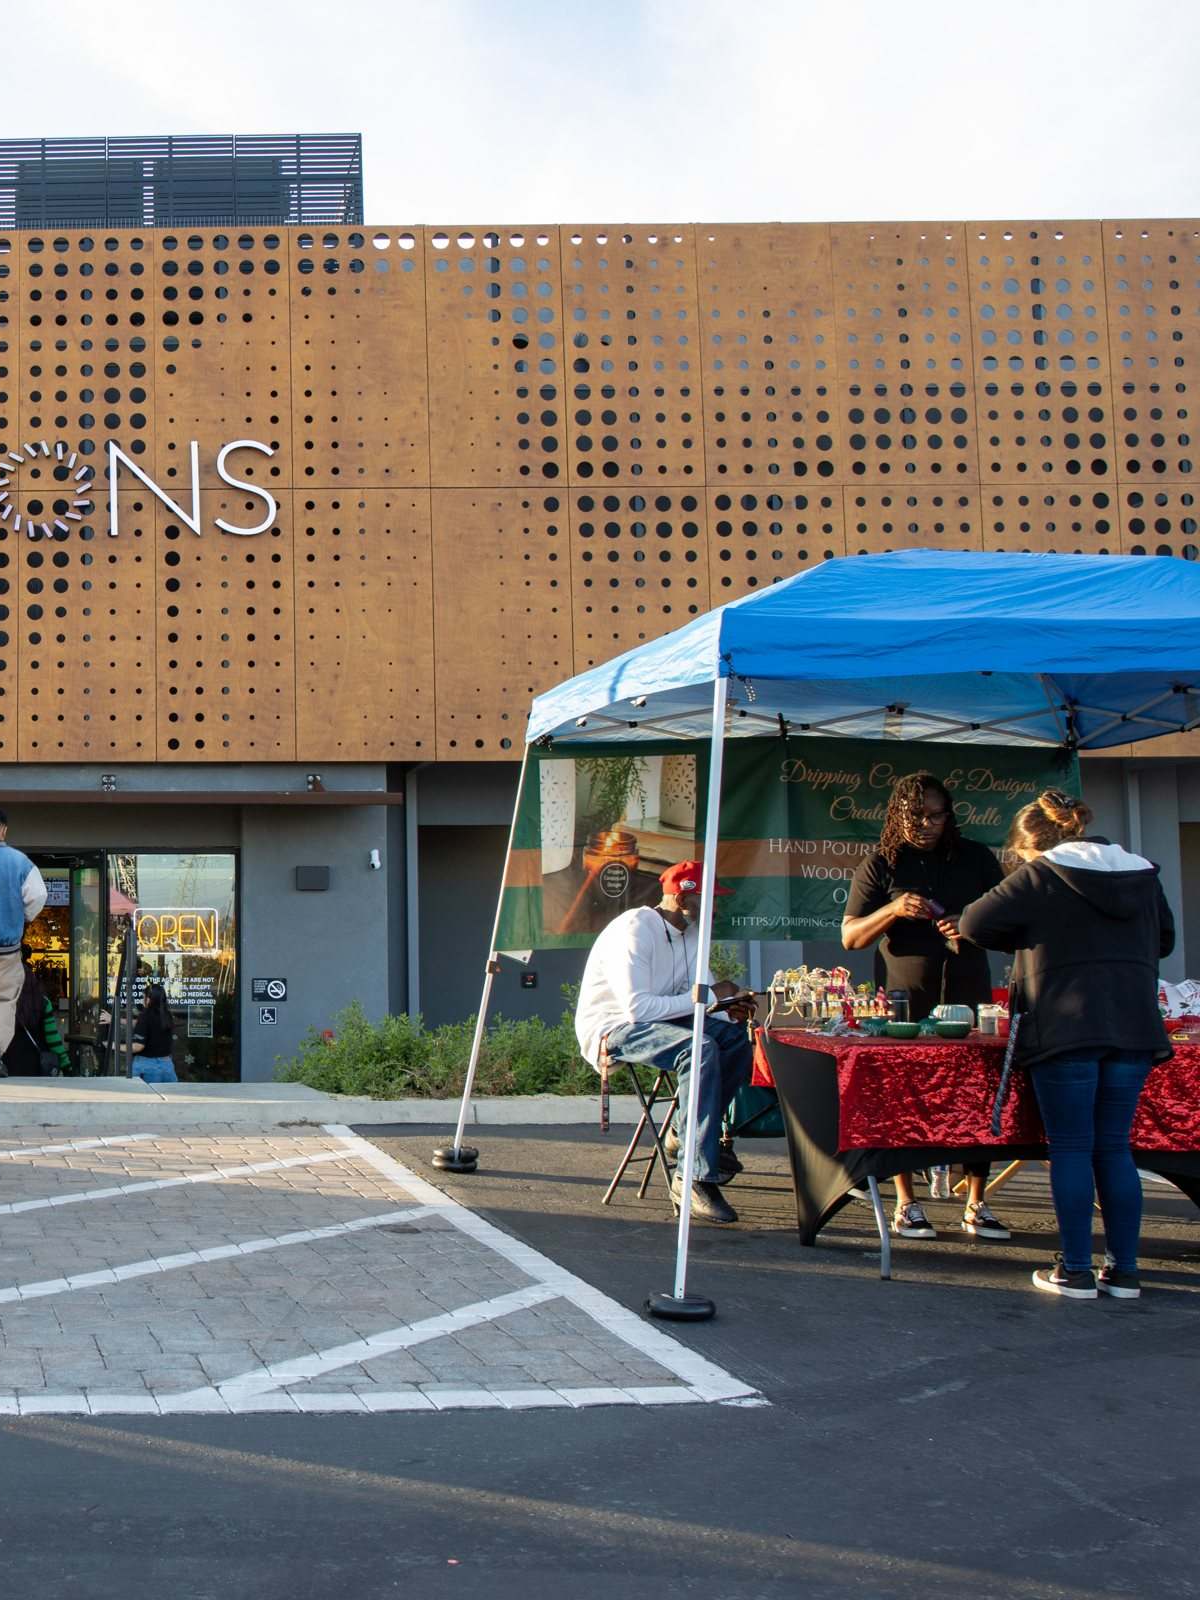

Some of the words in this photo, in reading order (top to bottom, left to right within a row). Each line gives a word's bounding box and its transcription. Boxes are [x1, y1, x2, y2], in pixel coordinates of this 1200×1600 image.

[779, 758, 864, 793] Dripping
[967, 767, 1036, 799] Designs
[768, 838, 817, 855] HAND
[138, 914, 215, 948] OPEN
